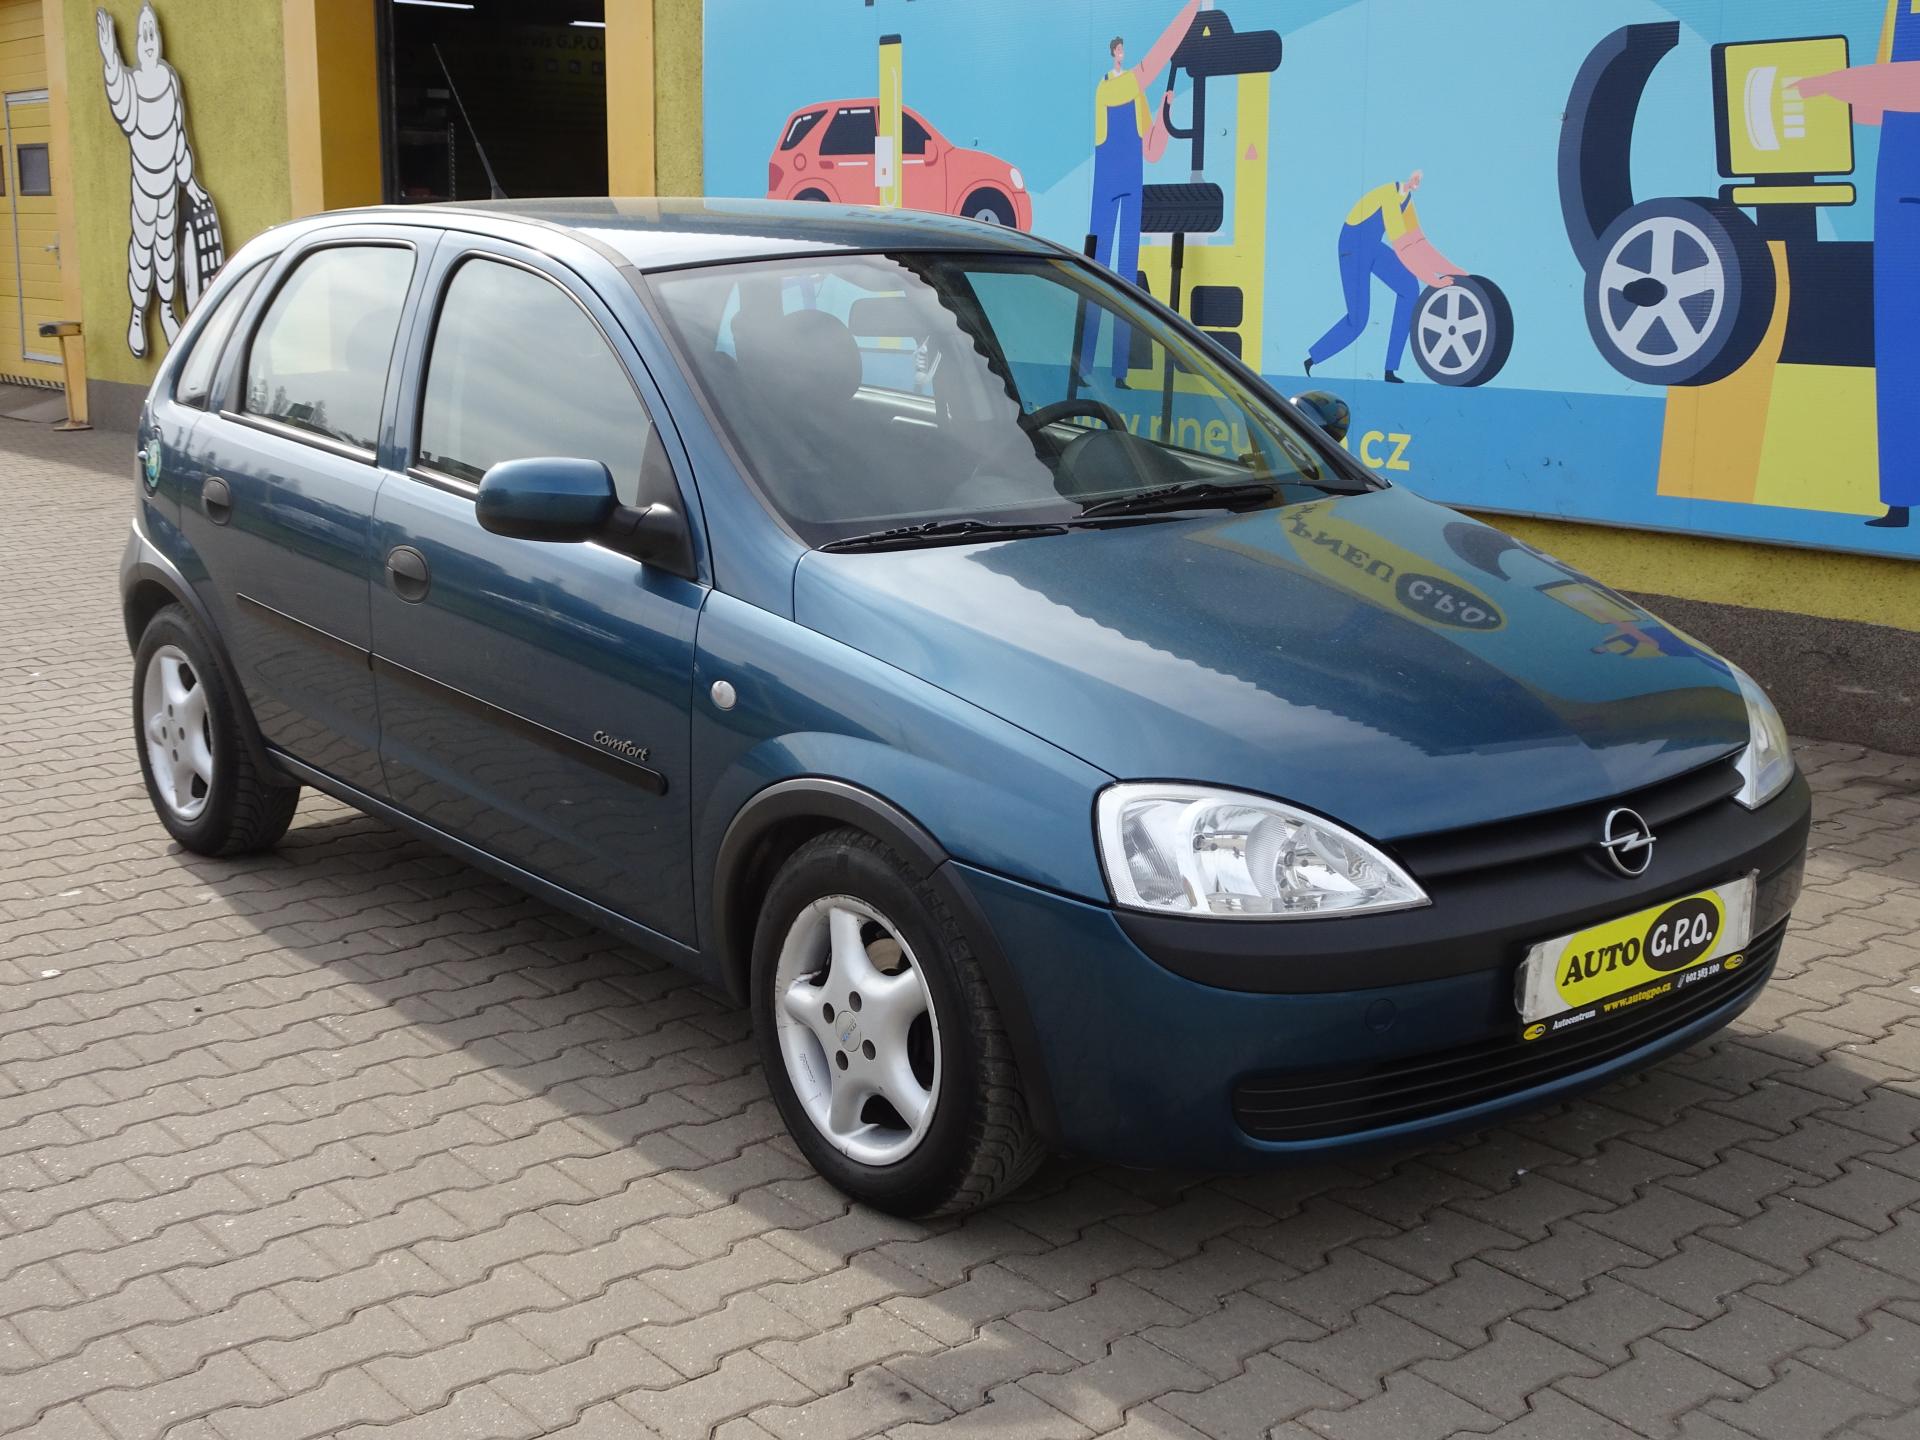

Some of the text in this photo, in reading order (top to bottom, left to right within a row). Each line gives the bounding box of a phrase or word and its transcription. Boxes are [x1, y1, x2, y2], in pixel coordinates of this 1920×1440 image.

[593, 730, 648, 761] Comfort
[1561, 912, 1713, 987] AUTO G.P.O.
[1552, 1009, 1596, 1030] Autocentrum
